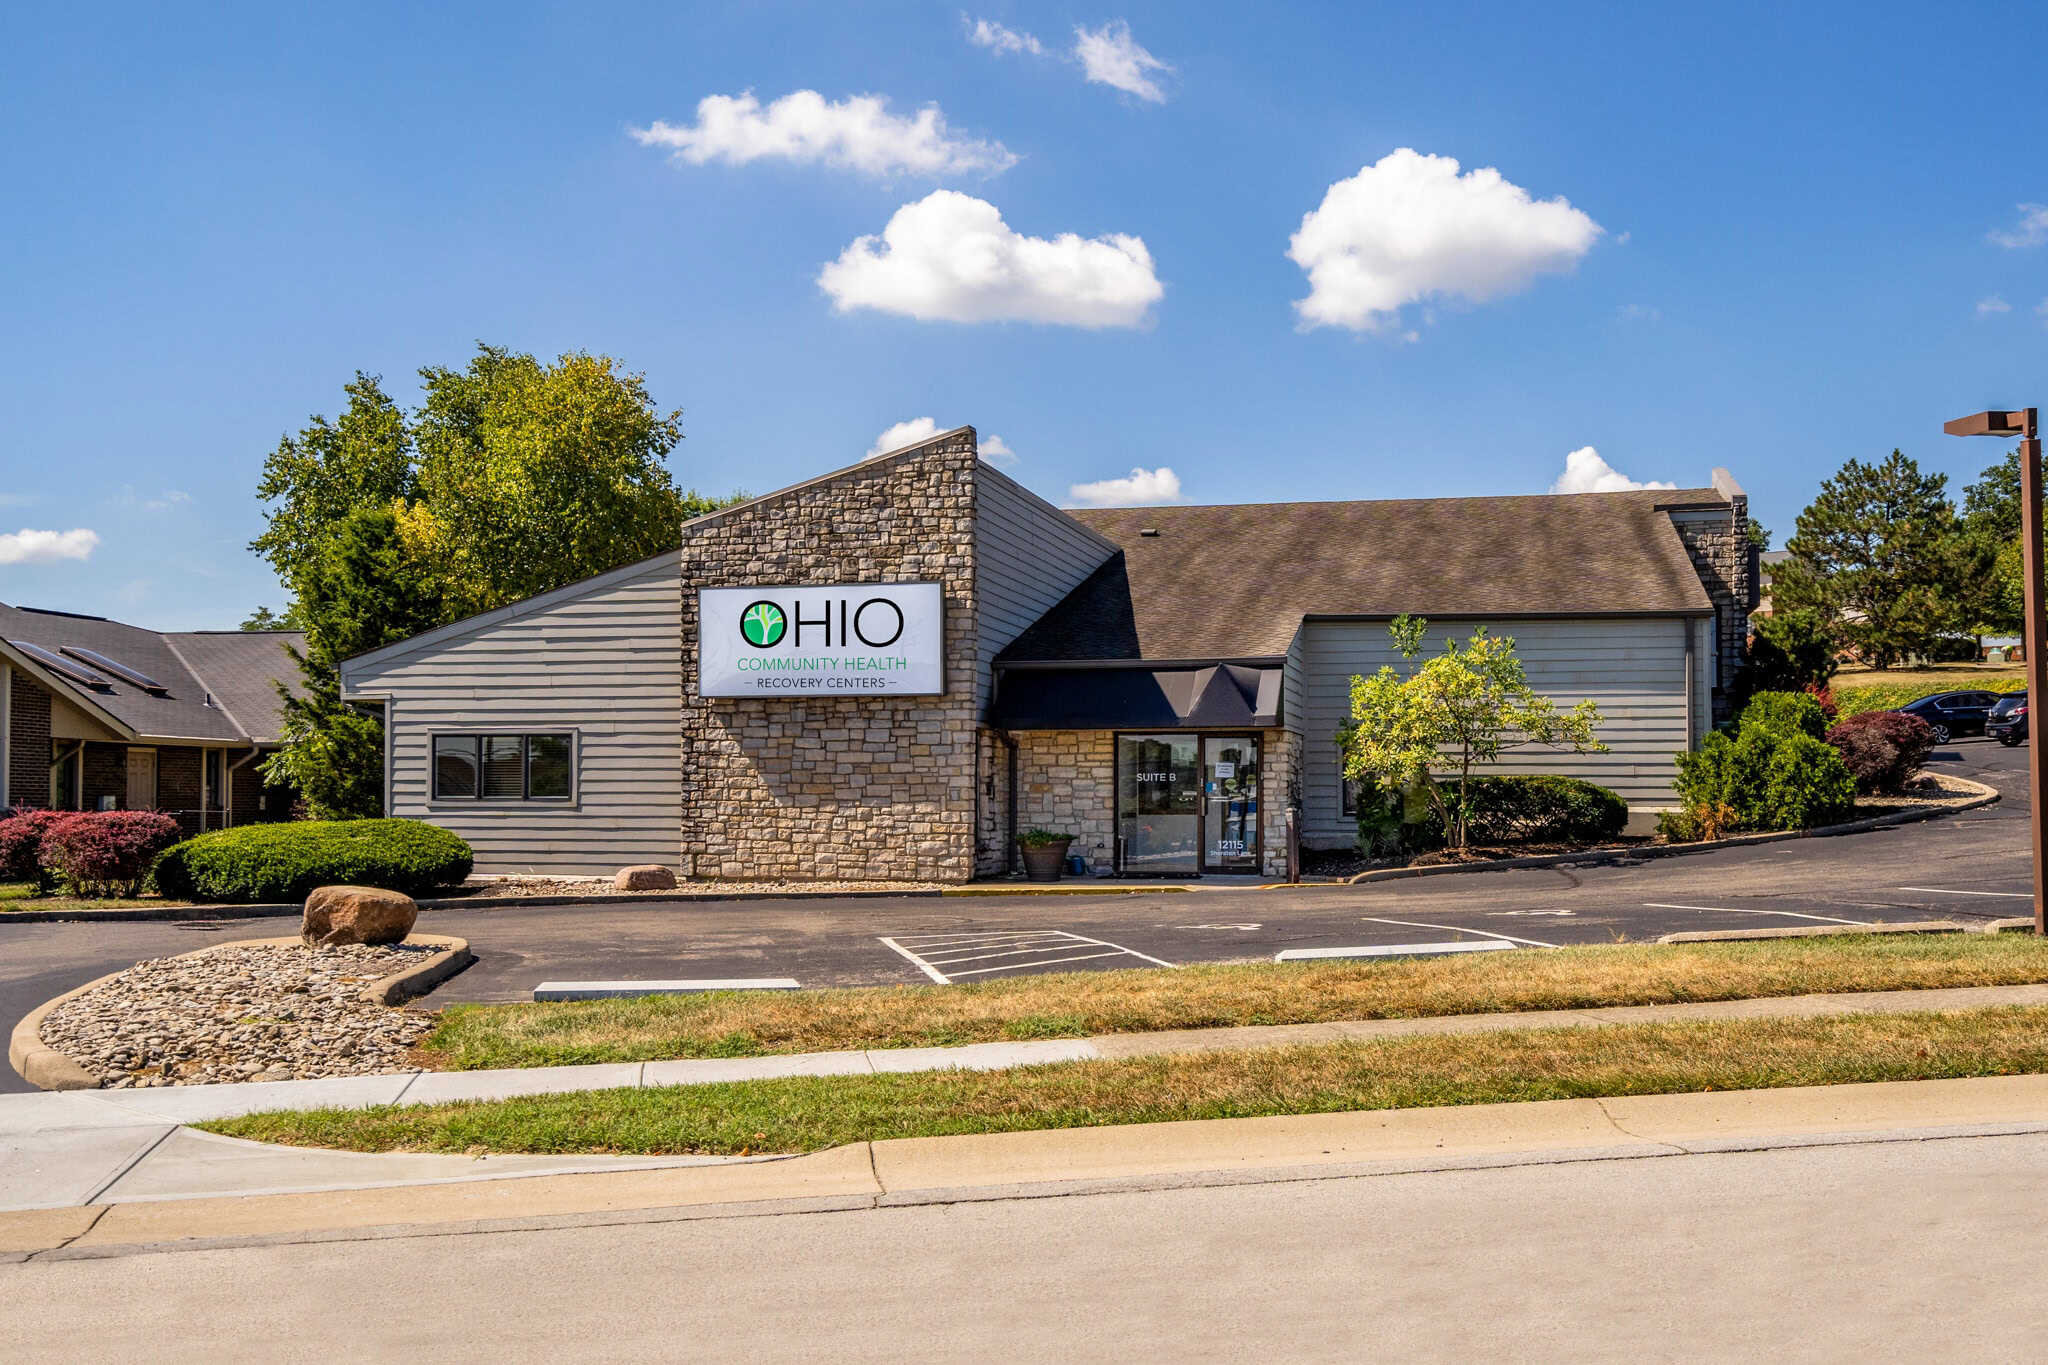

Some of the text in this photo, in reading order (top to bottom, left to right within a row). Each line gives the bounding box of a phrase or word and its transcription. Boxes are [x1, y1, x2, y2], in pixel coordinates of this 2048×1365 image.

[740, 598, 904, 648] OHIO
[737, 657, 906, 671] COMMUNITY HEALTH
[757, 678, 885, 688] RECOVERY CENTERS
[1136, 773, 1177, 782] SUITE B
[1217, 840, 1244, 850] 12115
